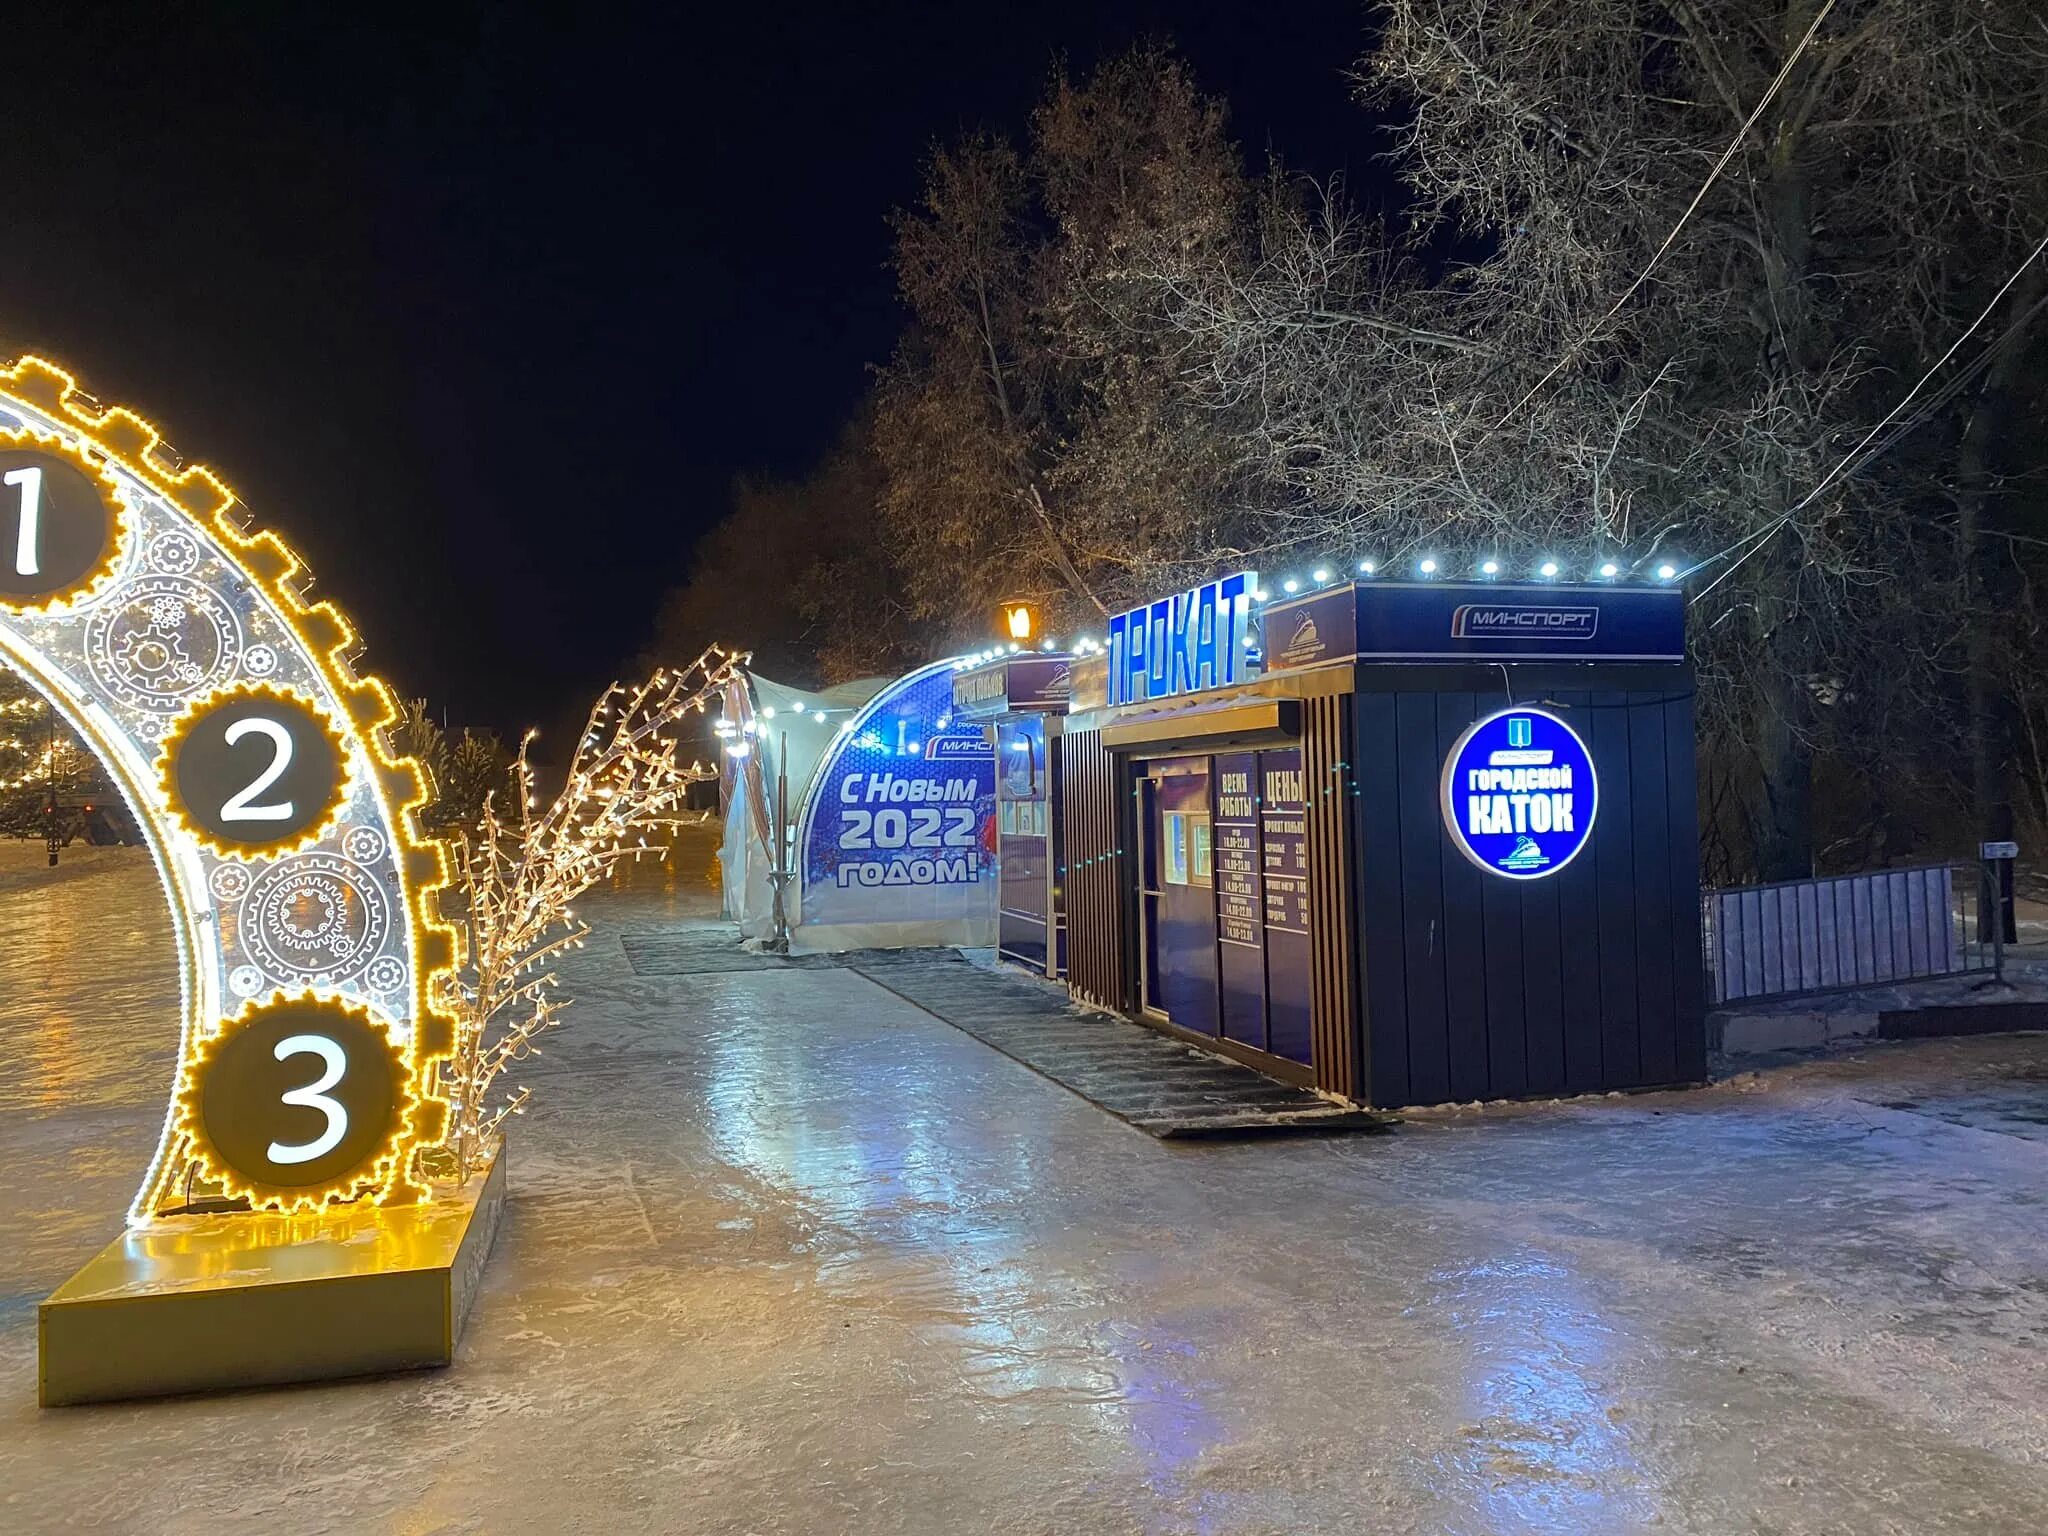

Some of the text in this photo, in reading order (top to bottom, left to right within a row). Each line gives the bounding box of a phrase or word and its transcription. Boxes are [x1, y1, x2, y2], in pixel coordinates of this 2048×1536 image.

[3, 466, 43, 576] 1
[1472, 611, 1591, 626] МИНСПОРТ
[1107, 572, 1250, 707] ПРОКАТ
[220, 717, 293, 821] 2
[1222, 773, 1247, 793] ВРЕМЯ
[1266, 770, 1303, 808] ЦЕНЫ
[1468, 764, 1573, 793] ГОРОДСКОЙ
[1220, 797, 1252, 816] РАБОТЫ
[1468, 793, 1574, 835] КАТОК
[839, 808, 976, 849] 2022
[266, 1035, 348, 1165] 3
